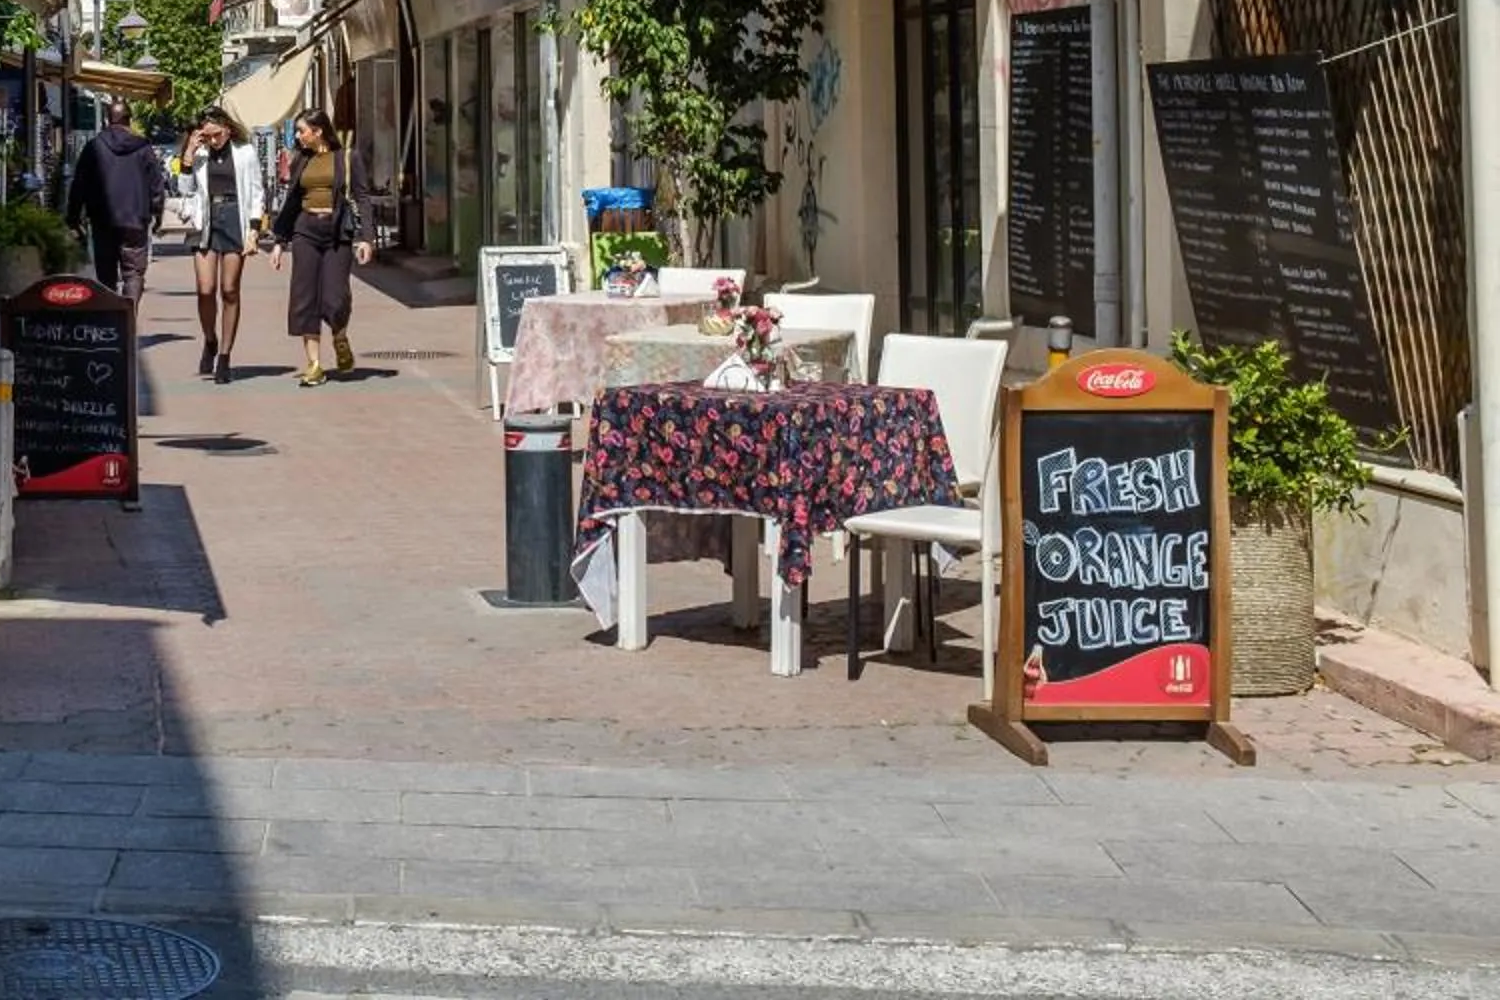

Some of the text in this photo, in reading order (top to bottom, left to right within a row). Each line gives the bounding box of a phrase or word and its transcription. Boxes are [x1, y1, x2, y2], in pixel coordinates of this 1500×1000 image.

[1087, 369, 1146, 391] Coca-Cola
[1036, 446, 1201, 515] FRESH
[1035, 526, 1210, 590] ORANGE
[1037, 596, 1193, 649] JUICE
